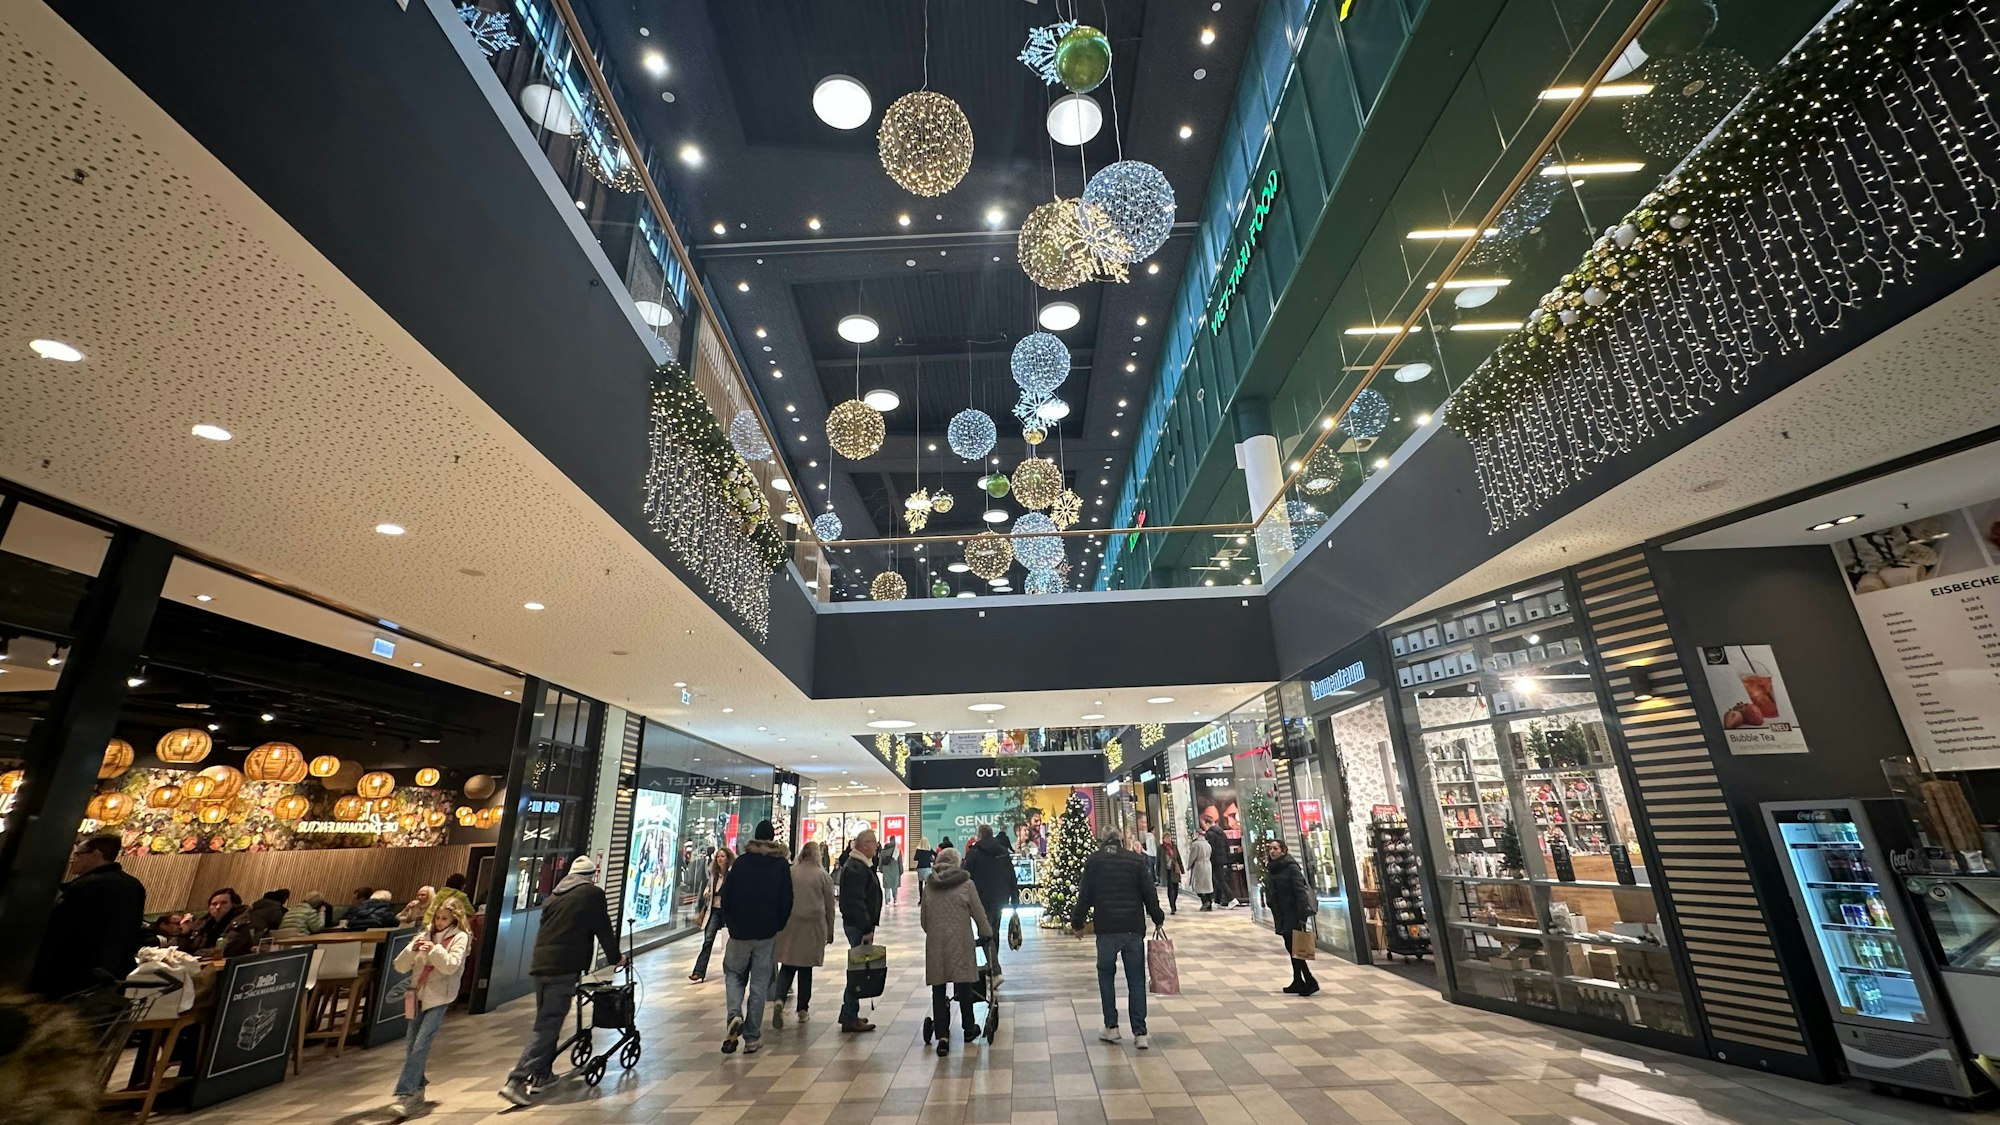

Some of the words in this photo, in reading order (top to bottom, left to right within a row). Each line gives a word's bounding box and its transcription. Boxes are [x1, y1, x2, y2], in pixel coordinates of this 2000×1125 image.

[1249, 169, 1278, 247] FOOD
[1926, 717, 1957, 725] Spaghetti
[1773, 723, 1789, 732] NEU
[1729, 734, 1759, 743] Bubble
[1760, 733, 1775, 742] Tea
[1934, 736, 1965, 744] Spaghetti
[1938, 746, 1969, 754] Spaghetti
[1205, 778, 1230, 787] BOSS
